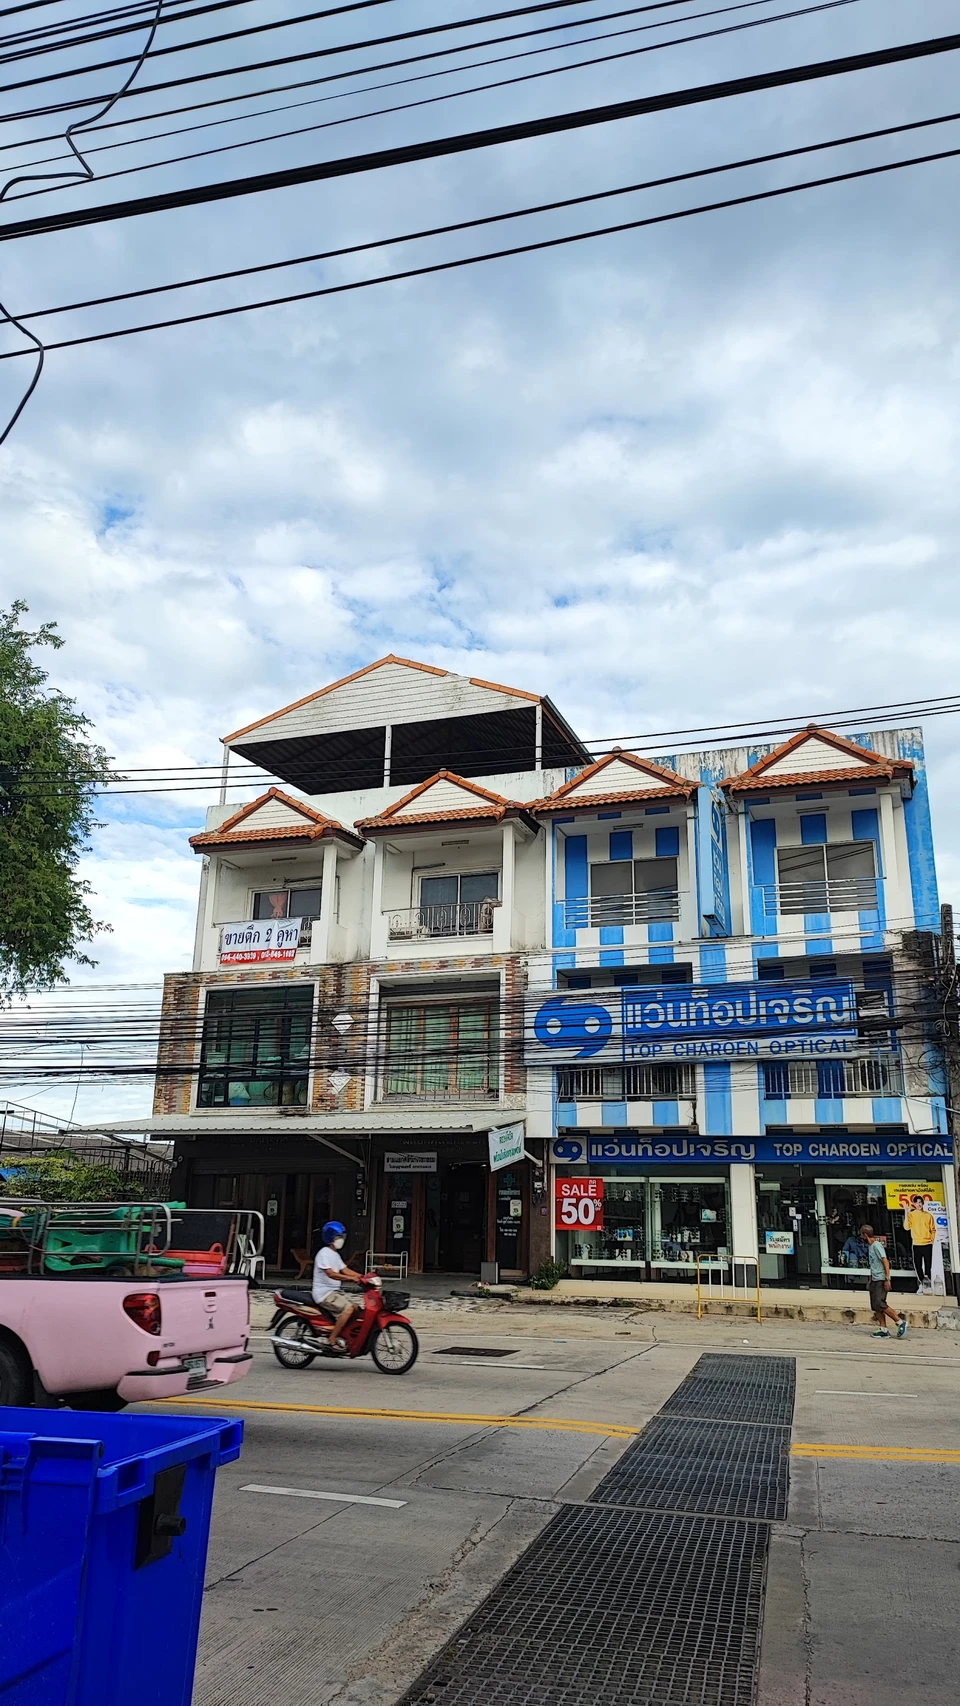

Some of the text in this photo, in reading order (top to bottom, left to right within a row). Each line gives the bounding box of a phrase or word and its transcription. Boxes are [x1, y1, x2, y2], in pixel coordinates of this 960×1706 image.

[225, 924, 298, 947] ขายตึก 2 คูหา
[626, 988, 850, 1029] แว่นท็อปเจริญ
[628, 1038, 853, 1058] TOP CHAROEN OPTICAL
[591, 1138, 756, 1160] แว่นท็อปเจริญ
[773, 1143, 953, 1157] TOP CHAROEN OPTICAL
[561, 1183, 597, 1196] SALE
[767, 1241, 793, 1250] พนักงาน
